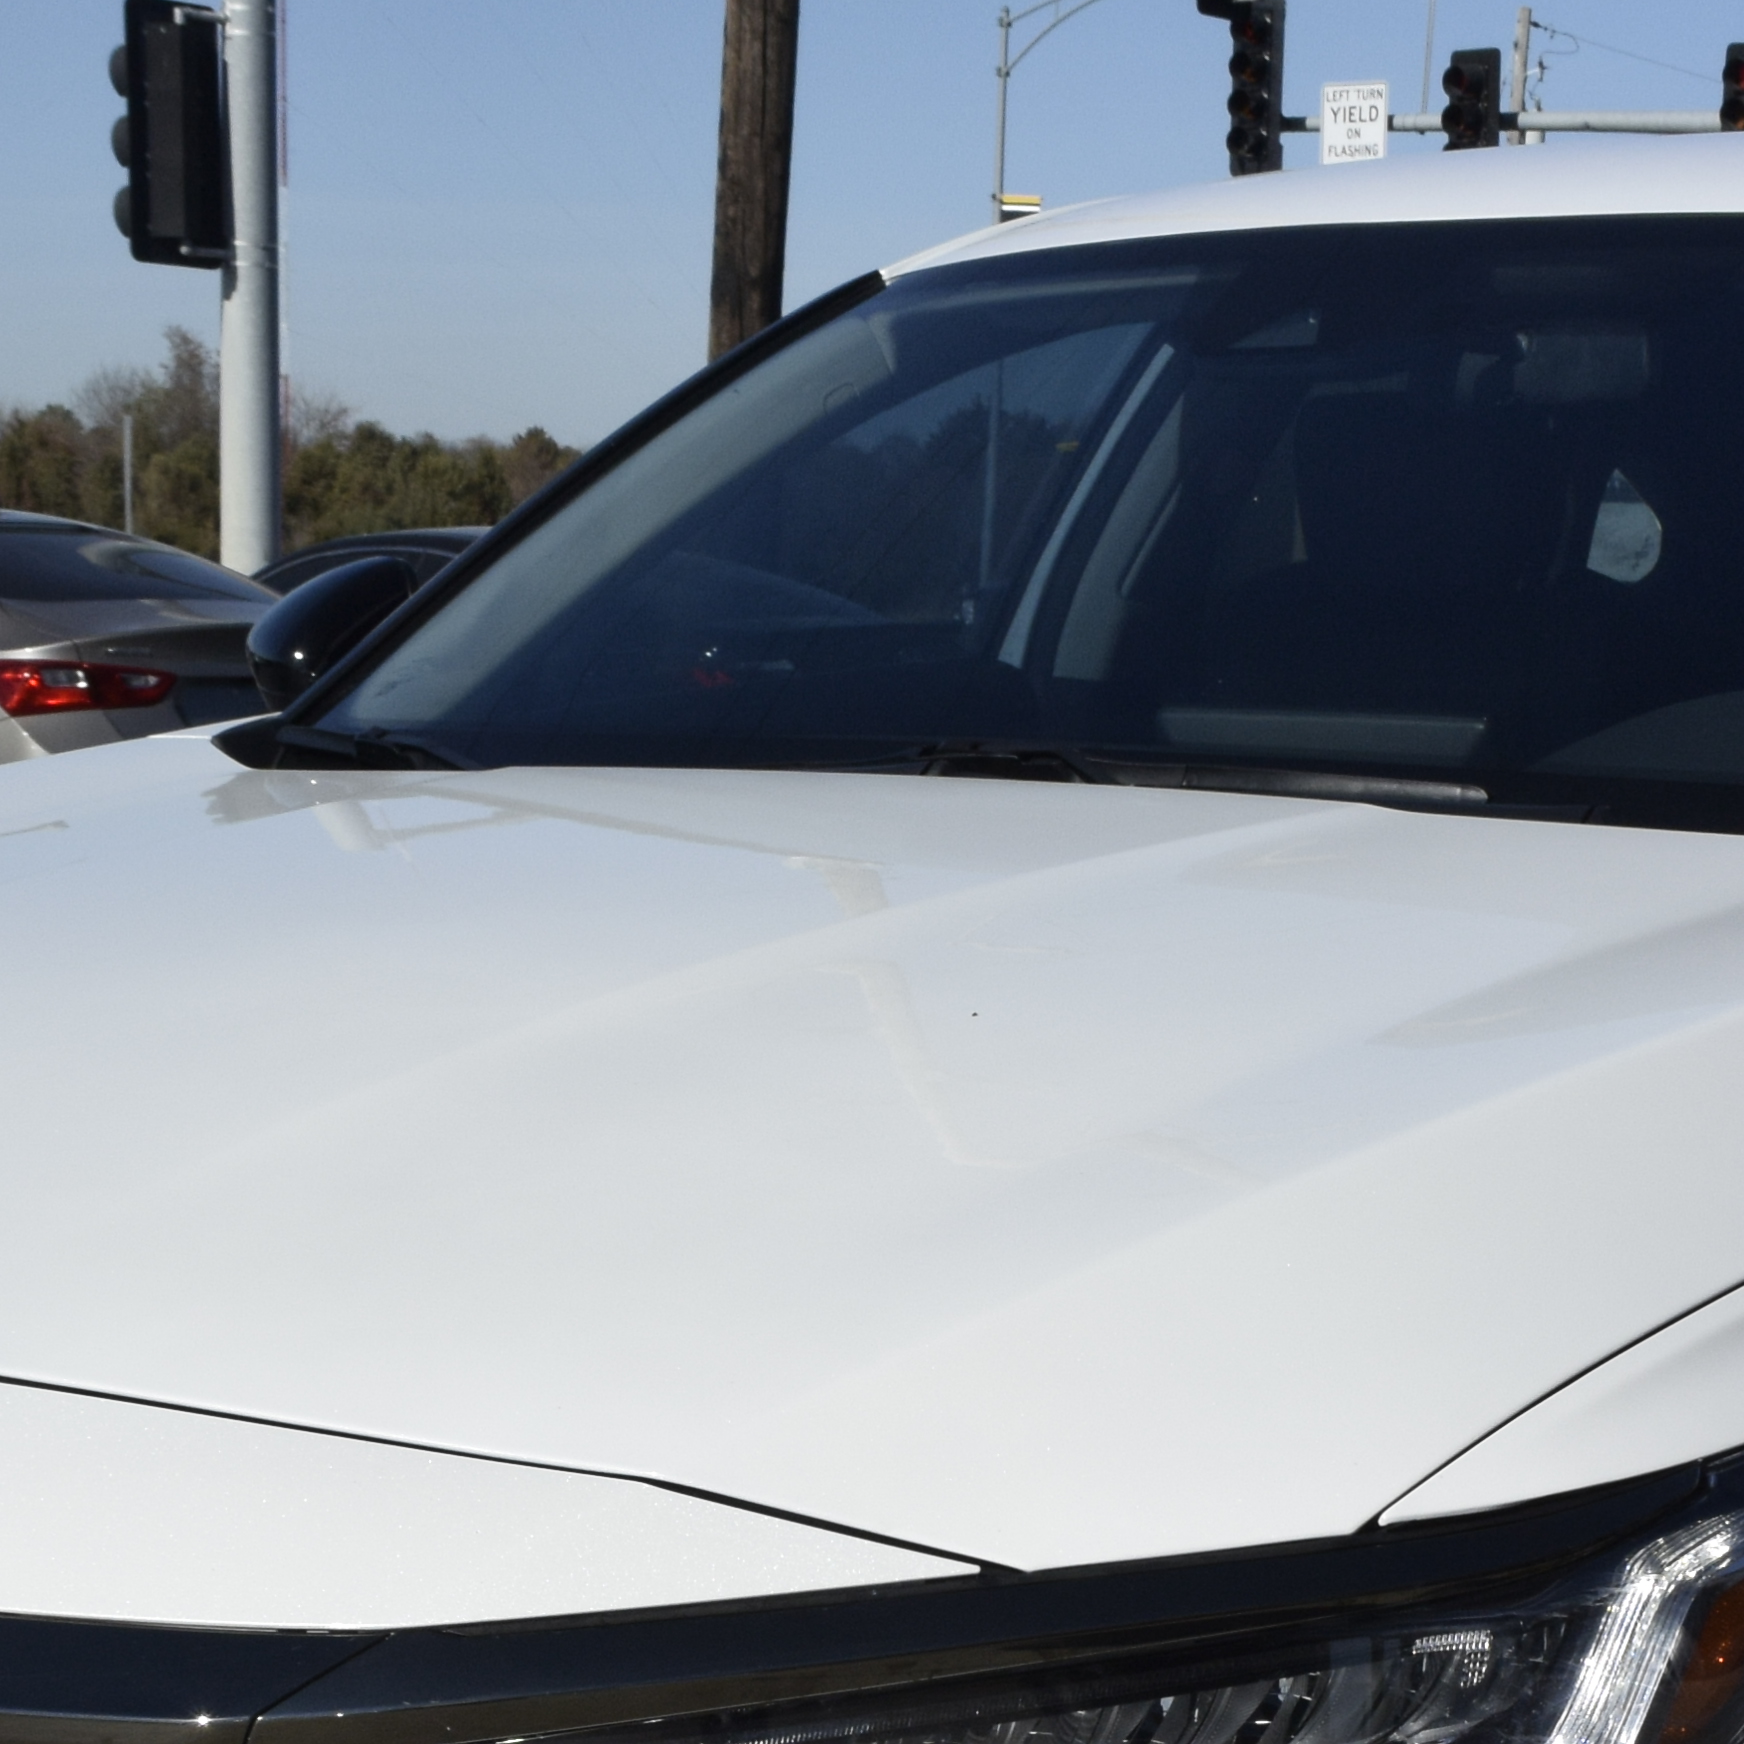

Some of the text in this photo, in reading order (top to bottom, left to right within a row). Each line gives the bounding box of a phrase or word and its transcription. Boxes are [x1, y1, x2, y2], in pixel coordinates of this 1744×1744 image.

[1326, 88, 1383, 102] LEFT TURN
[1330, 105, 1379, 123] YIELD
[1347, 128, 1361, 139] ON
[1328, 144, 1378, 157] FLASHING
